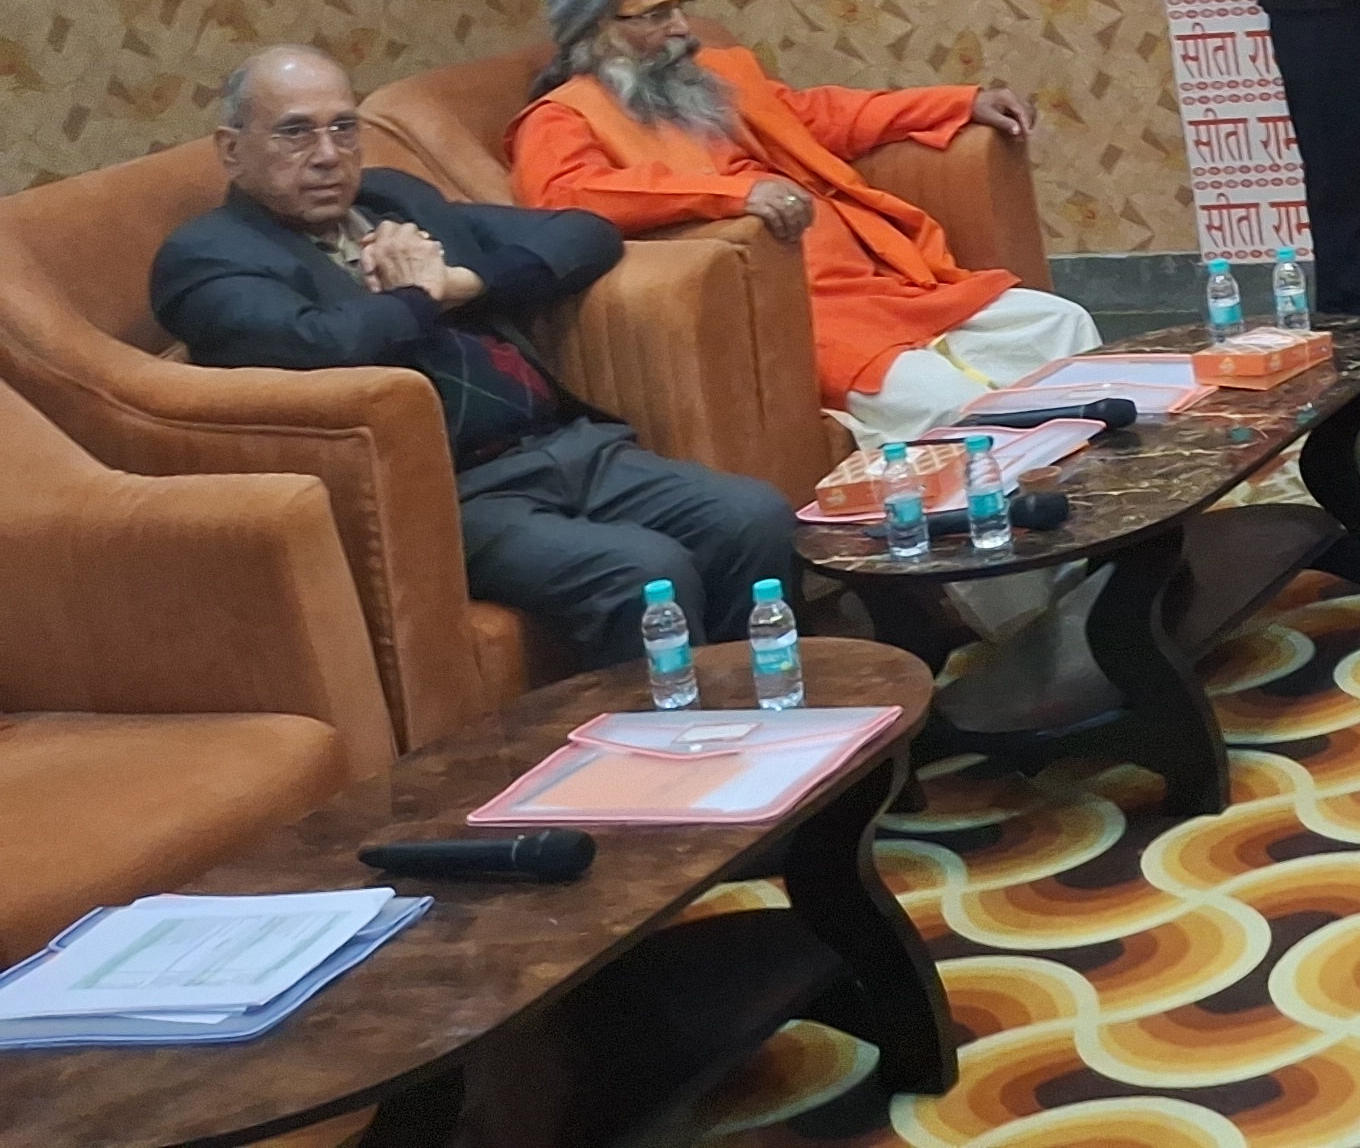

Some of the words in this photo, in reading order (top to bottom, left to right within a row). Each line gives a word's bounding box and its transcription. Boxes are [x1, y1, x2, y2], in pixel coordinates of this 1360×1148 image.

[1174, 22, 1241, 79] सीता
[1244, 29, 1273, 77] रा
[1187, 108, 1251, 163] सीता
[1199, 192, 1264, 248] सीता
